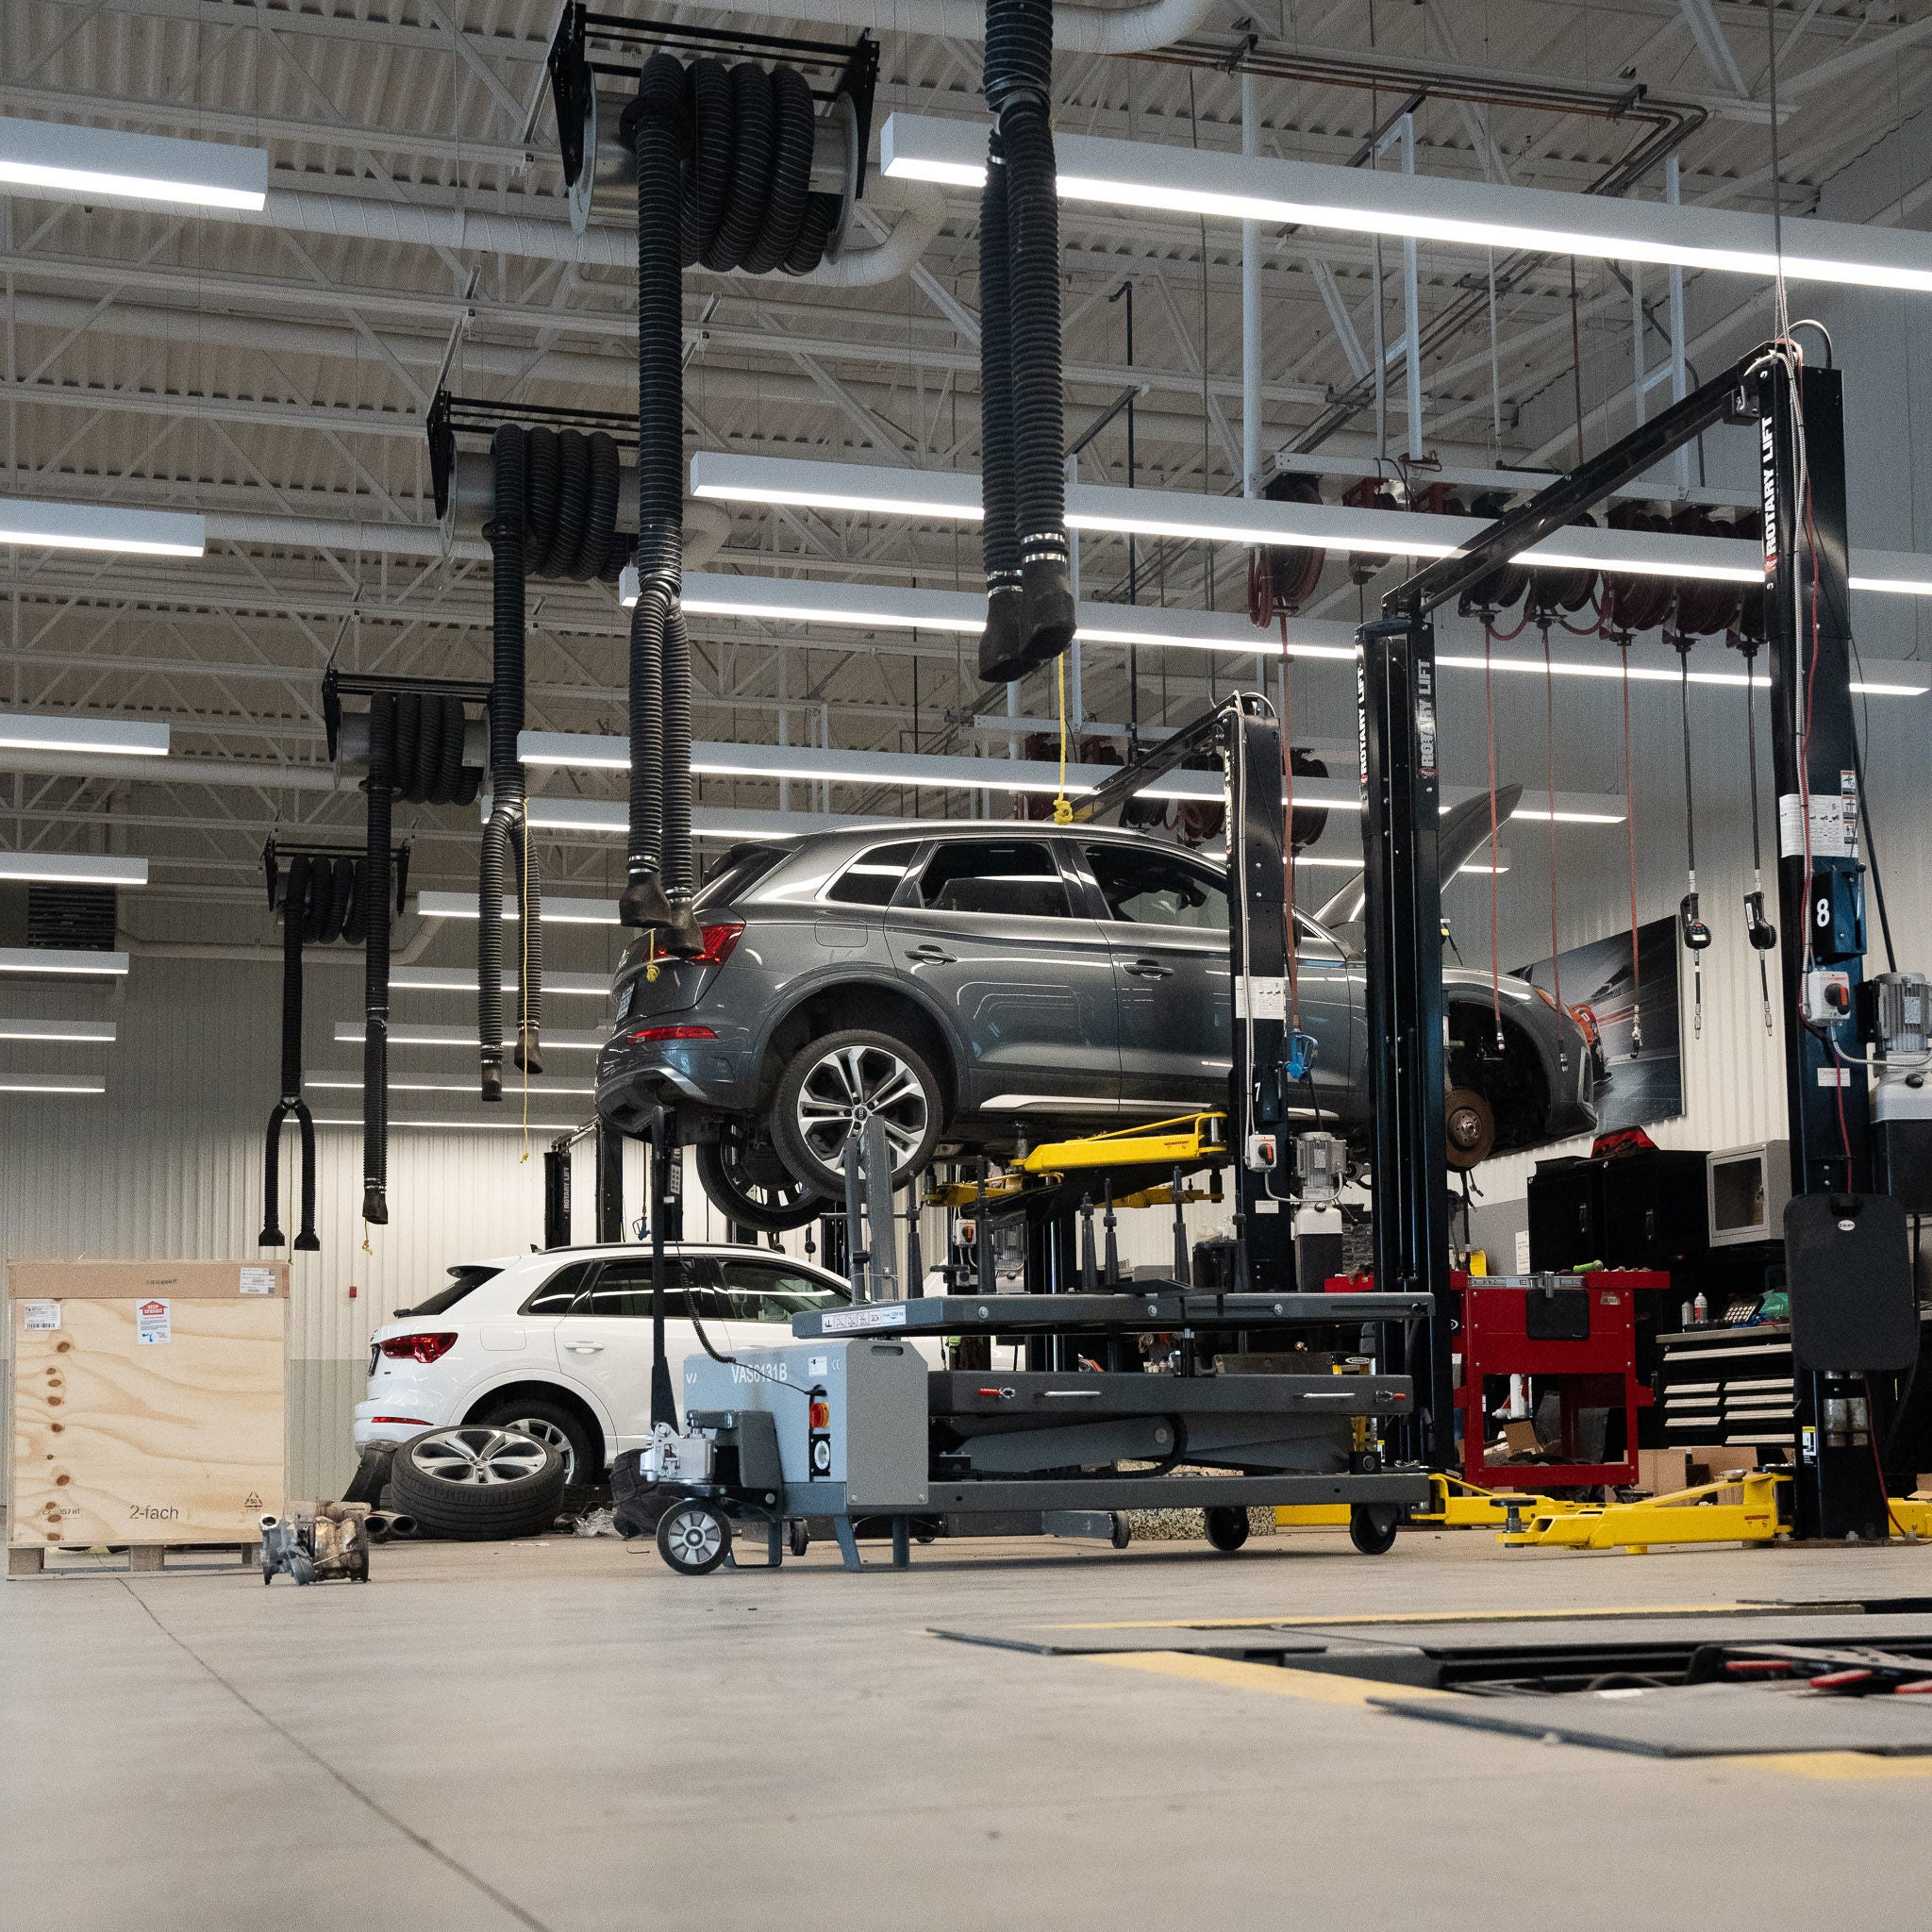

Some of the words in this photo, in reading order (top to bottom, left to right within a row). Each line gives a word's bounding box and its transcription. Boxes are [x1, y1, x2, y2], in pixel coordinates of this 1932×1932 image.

[1761, 415, 1774, 463] LIFT
[1764, 469, 1776, 556] ROTARY
[1357, 668, 1365, 705] LIFT
[1418, 658, 1431, 695] LIFT
[1358, 708, 1367, 775] ROTARY
[1419, 698, 1434, 767] ROTARY
[1816, 898, 1830, 927] 8
[128, 1504, 178, 1521] 2-fach
